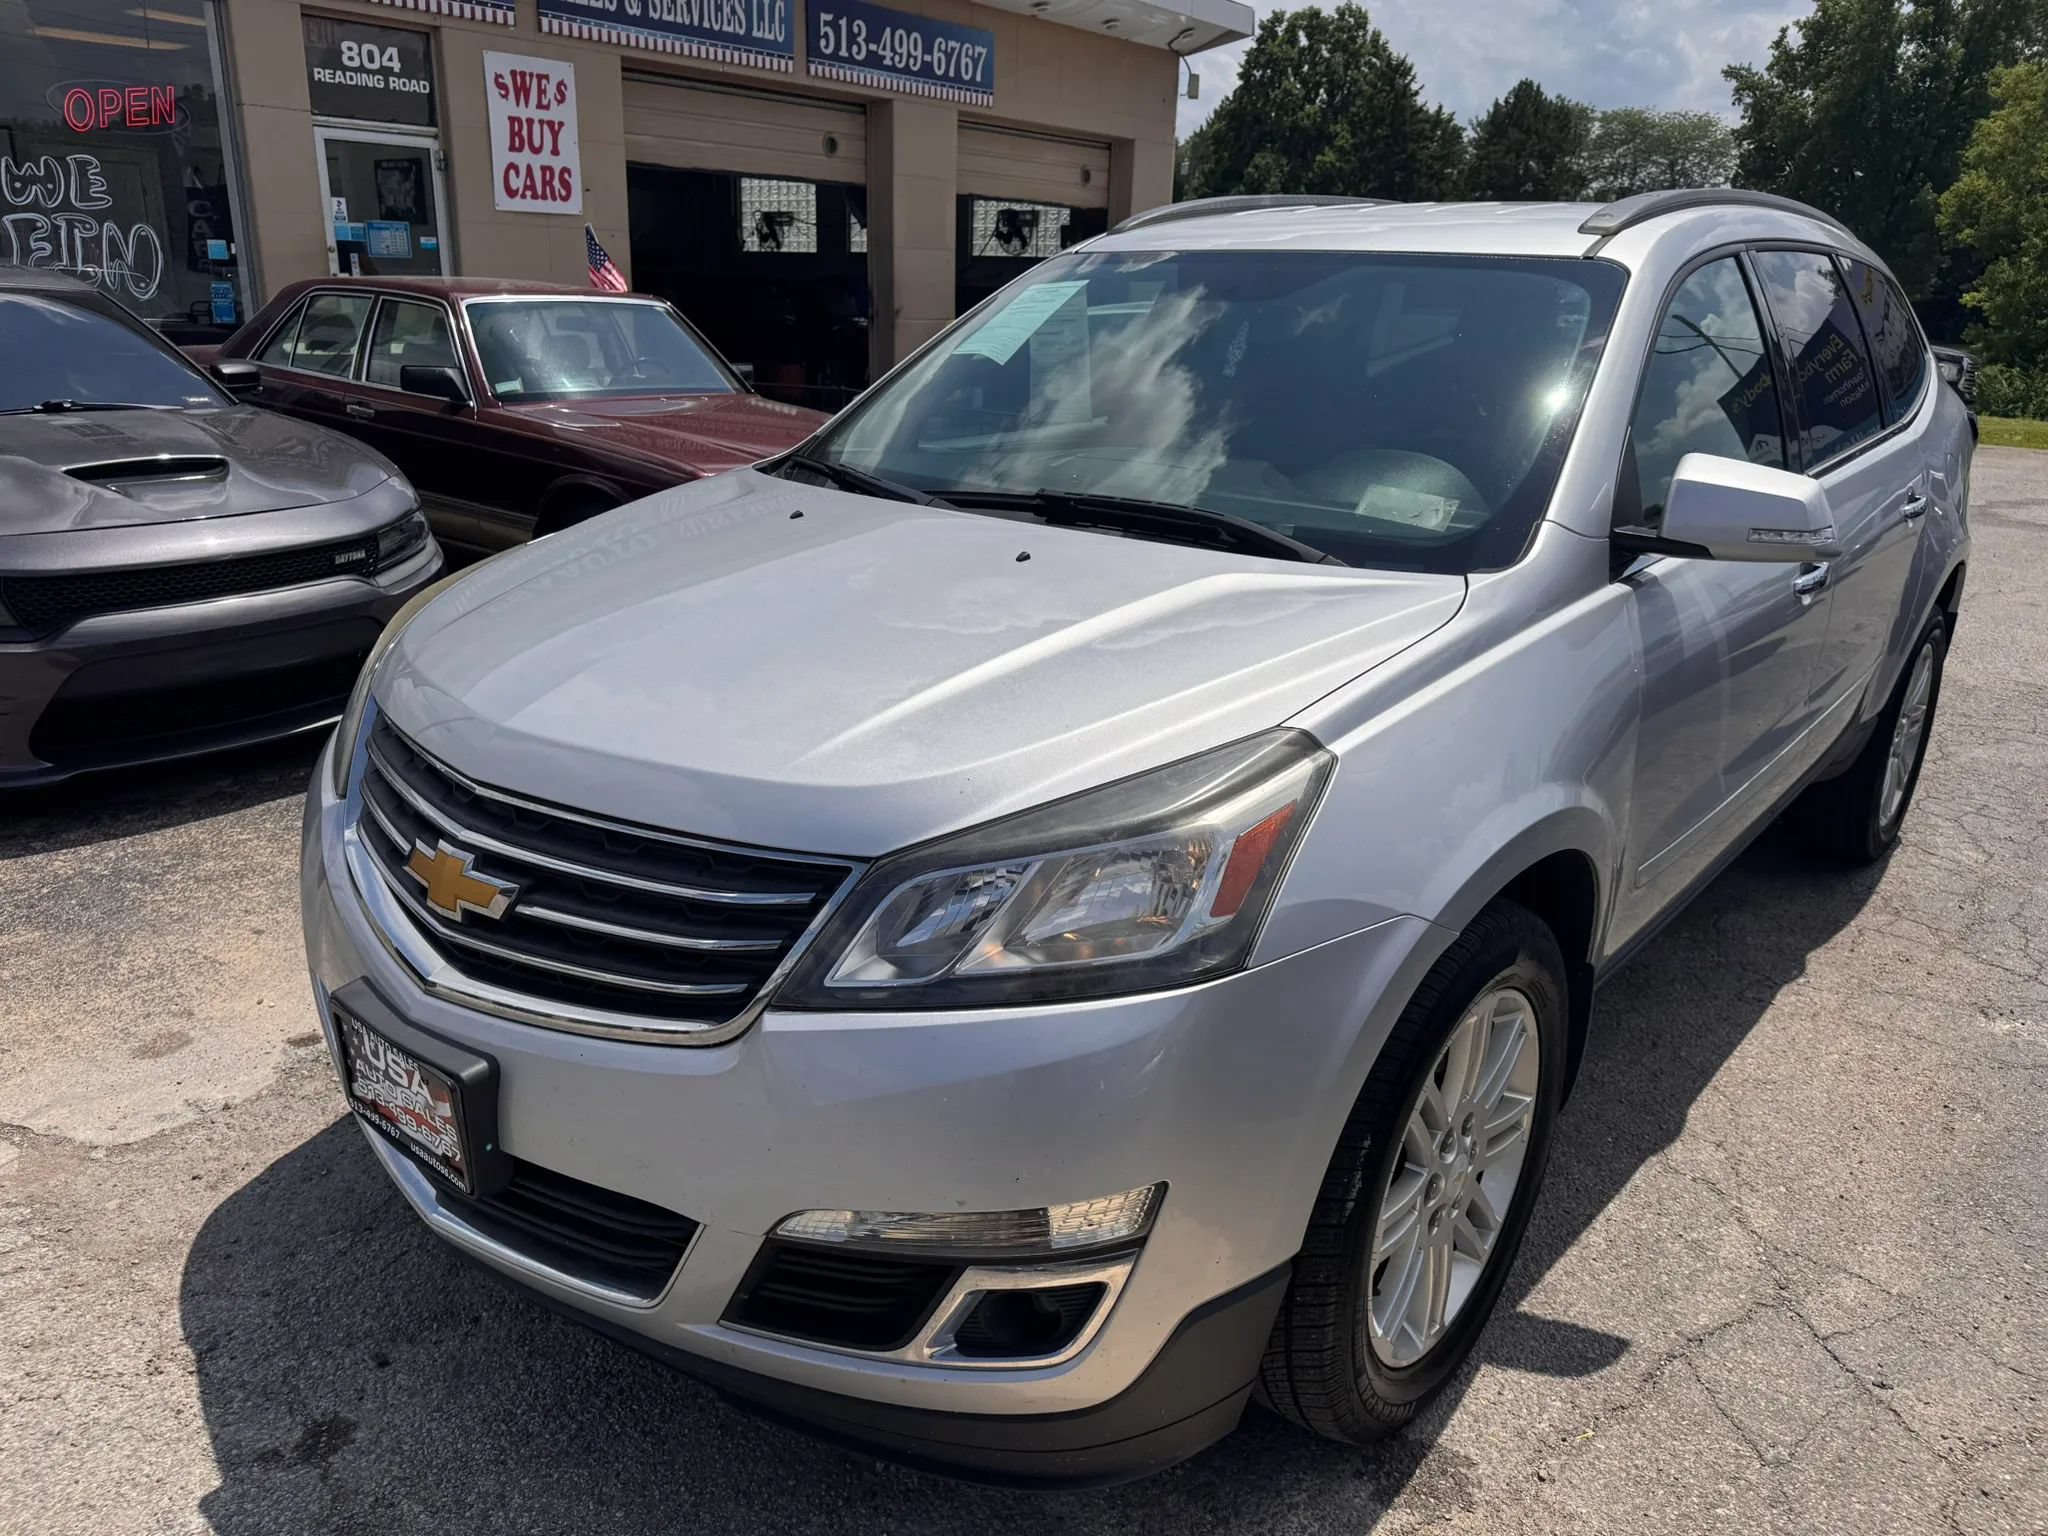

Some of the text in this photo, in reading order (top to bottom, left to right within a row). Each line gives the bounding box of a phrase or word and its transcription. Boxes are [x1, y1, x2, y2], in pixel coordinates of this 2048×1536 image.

[751, 0, 785, 43] LLC
[340, 40, 402, 73] 804
[819, 11, 988, 83] 513-499-6767
[312, 67, 431, 95] READING ROAD
[63, 85, 176, 133] OPEN
[507, 115, 565, 157] BUY
[1, 154, 113, 210] WE
[502, 161, 573, 203] CARS
[335, 550, 366, 564] DAYTONA
[362, 1028, 435, 1108] USA
[393, 1048, 419, 1072] SALES
[355, 1058, 459, 1143] AUTO SALES
[410, 1142, 467, 1193] usaautoss.com
